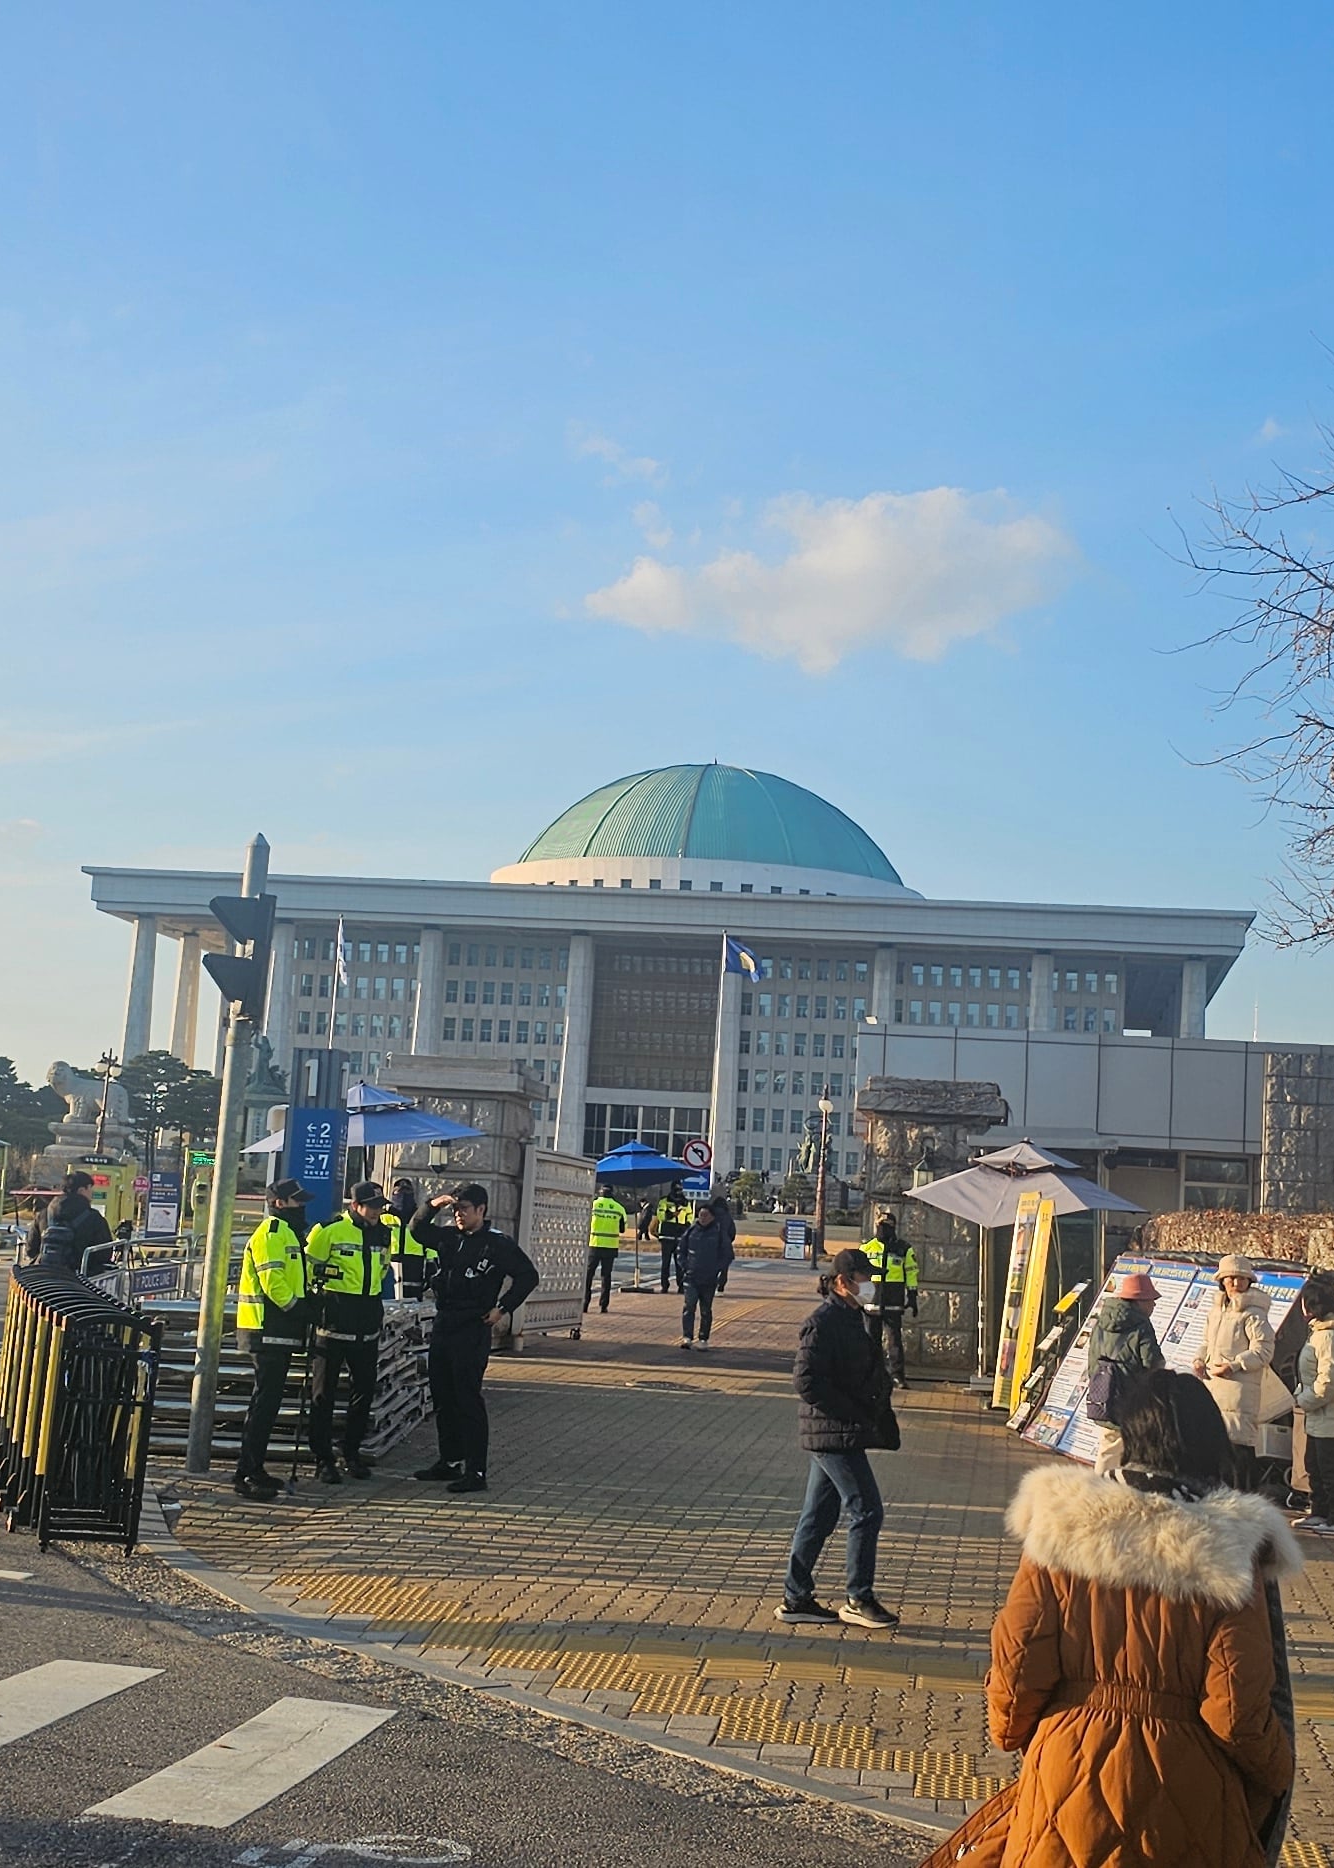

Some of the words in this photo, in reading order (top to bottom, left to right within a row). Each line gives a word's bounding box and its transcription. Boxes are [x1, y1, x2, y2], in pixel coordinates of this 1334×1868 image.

[305, 1058, 319, 1097] 1
[320, 1122, 331, 1138] 2
[318, 1154, 329, 1170] 7
[141, 1273, 160, 1288] POLICE
[160, 1271, 171, 1286] LINE
